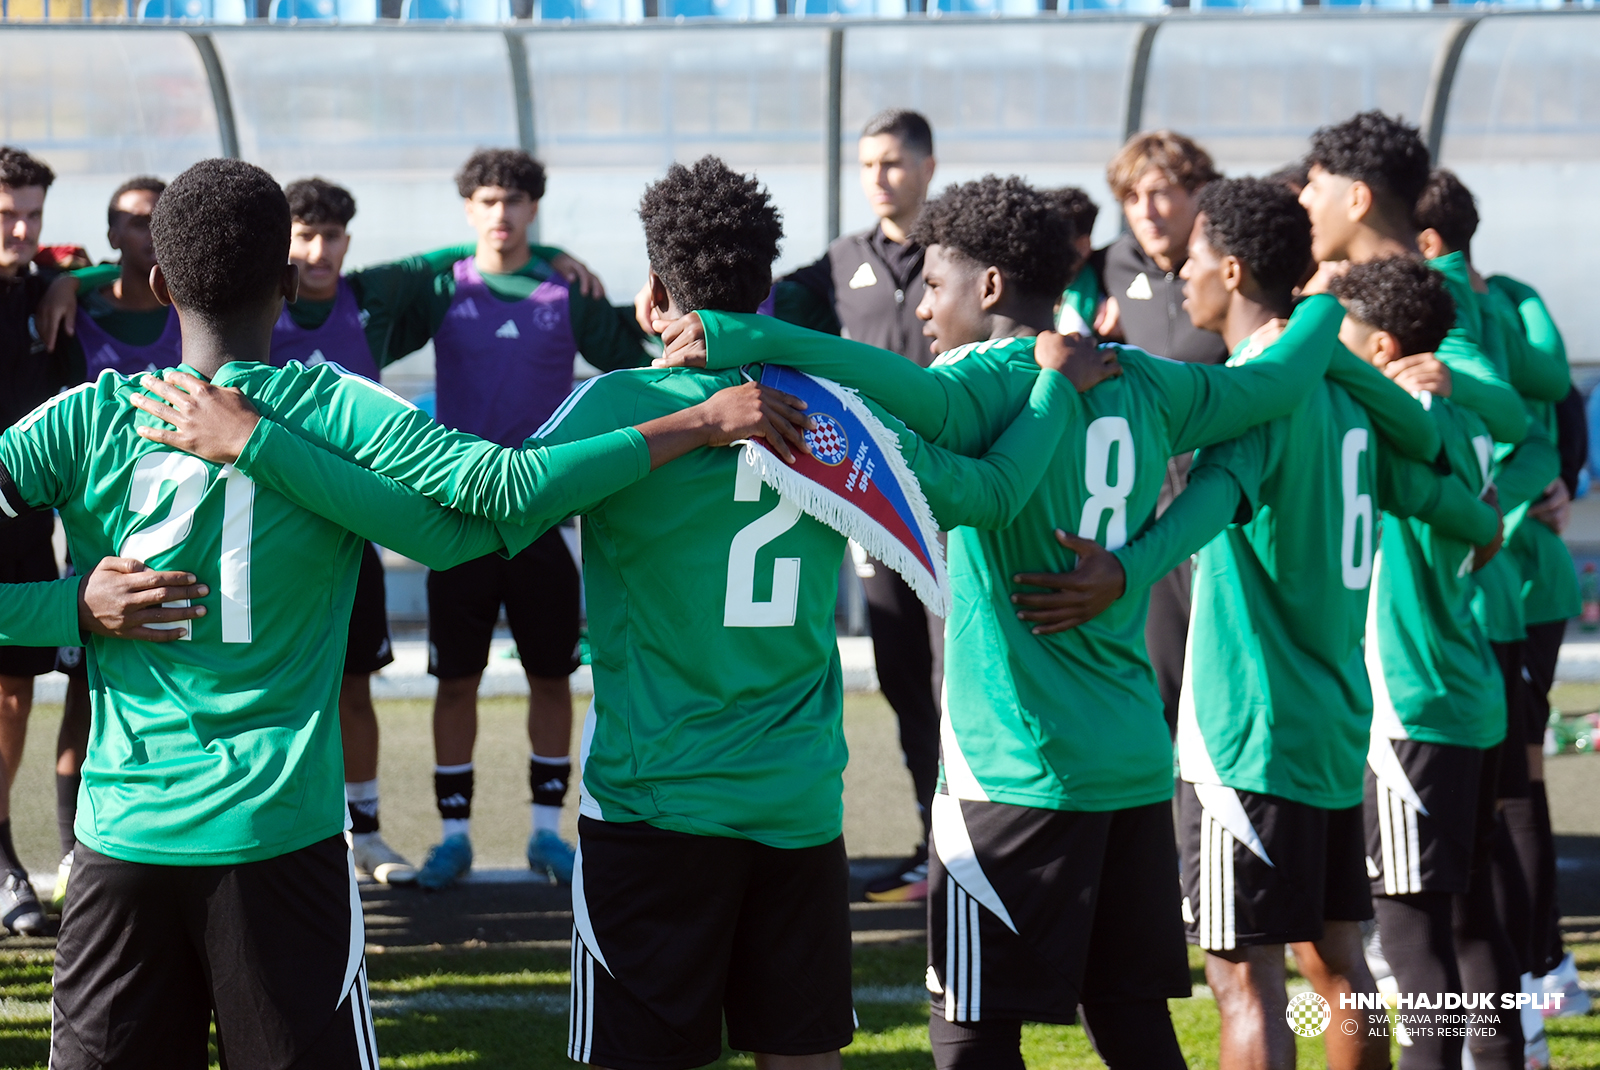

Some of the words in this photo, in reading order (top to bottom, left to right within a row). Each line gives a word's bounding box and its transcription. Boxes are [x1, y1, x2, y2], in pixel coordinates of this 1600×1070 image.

[831, 436, 847, 464] SPLIT
[845, 441, 869, 492] HAJDUK
[858, 458, 876, 493] SPLIT
[1075, 416, 1136, 552] 8
[1341, 427, 1372, 590] 6
[119, 452, 256, 643] 21
[723, 444, 804, 627] 2
